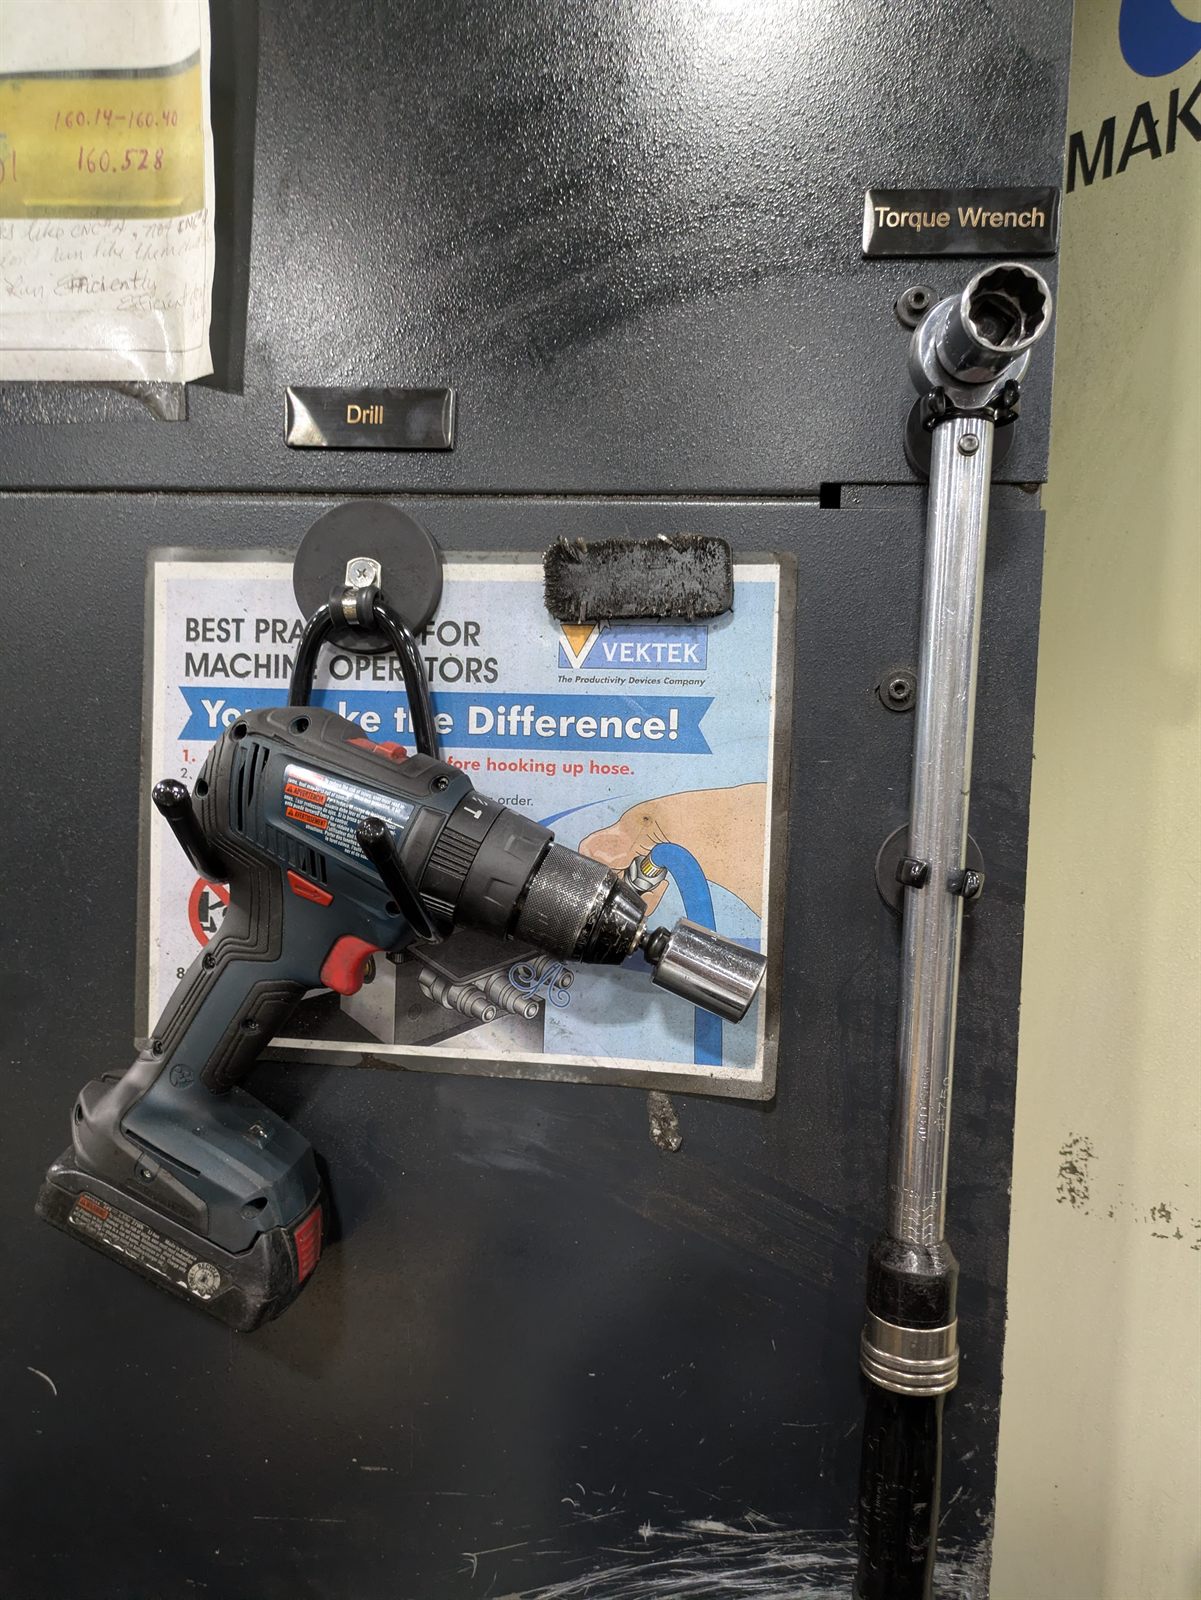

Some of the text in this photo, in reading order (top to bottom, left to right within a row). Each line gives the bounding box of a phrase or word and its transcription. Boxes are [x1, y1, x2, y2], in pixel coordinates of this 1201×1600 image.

[77, 146, 164, 173] 160.528
[874, 207, 1045, 232] Torque Wrench
[346, 404, 384, 425] Drill
[186, 617, 245, 643] BEST
[422, 620, 480, 646] FOR
[602, 642, 700, 663] VEKTEK
[185, 652, 498, 683] MACHIN OPERTORS
[558, 675, 706, 687] The Productivity Devices Company
[201, 700, 251, 728] Yo
[394, 707, 453, 734] te
[467, 704, 679, 740] Difference!
[180, 767, 193, 780] 2.
[183, 749, 635, 777] 1. fore hooking up hose.
[498, 794, 534, 806] order.
